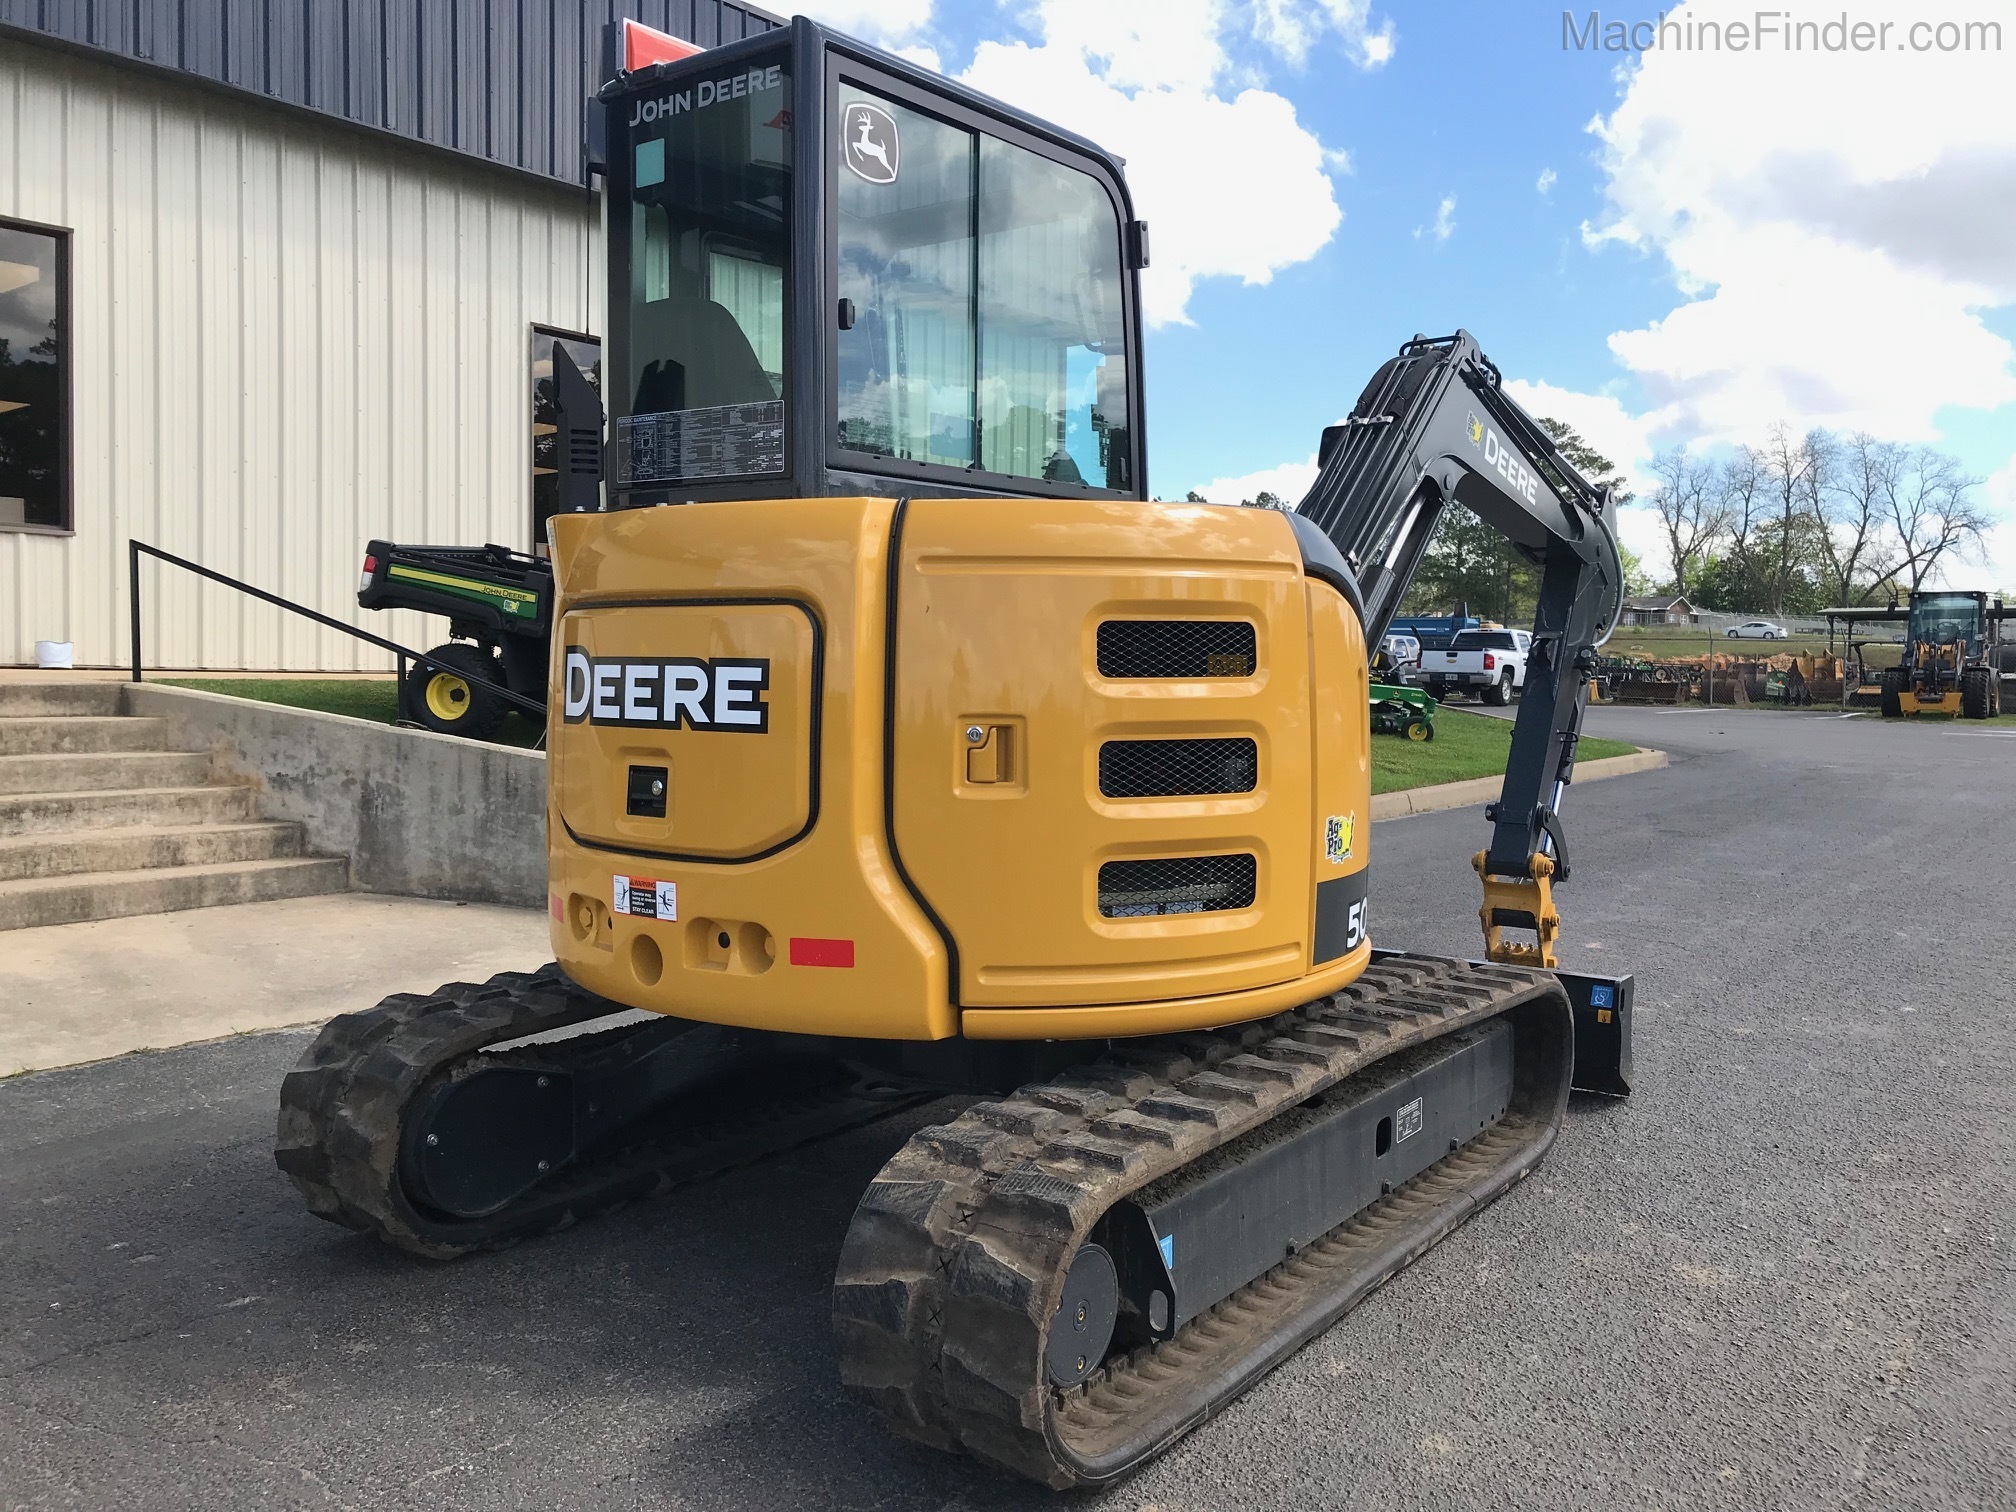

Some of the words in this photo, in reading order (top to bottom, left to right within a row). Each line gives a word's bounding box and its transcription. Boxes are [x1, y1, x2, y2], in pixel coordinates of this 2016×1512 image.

[628, 90, 691, 128] JOHN
[697, 64, 781, 109] DEERE
[1484, 427, 1538, 506] DEERE
[481, 585, 502, 596] JOHN
[502, 590, 528, 600] DEERE
[564, 652, 763, 726] DEERE
[634, 880, 656, 889] WARNING
[1346, 896, 1368, 949] 50
